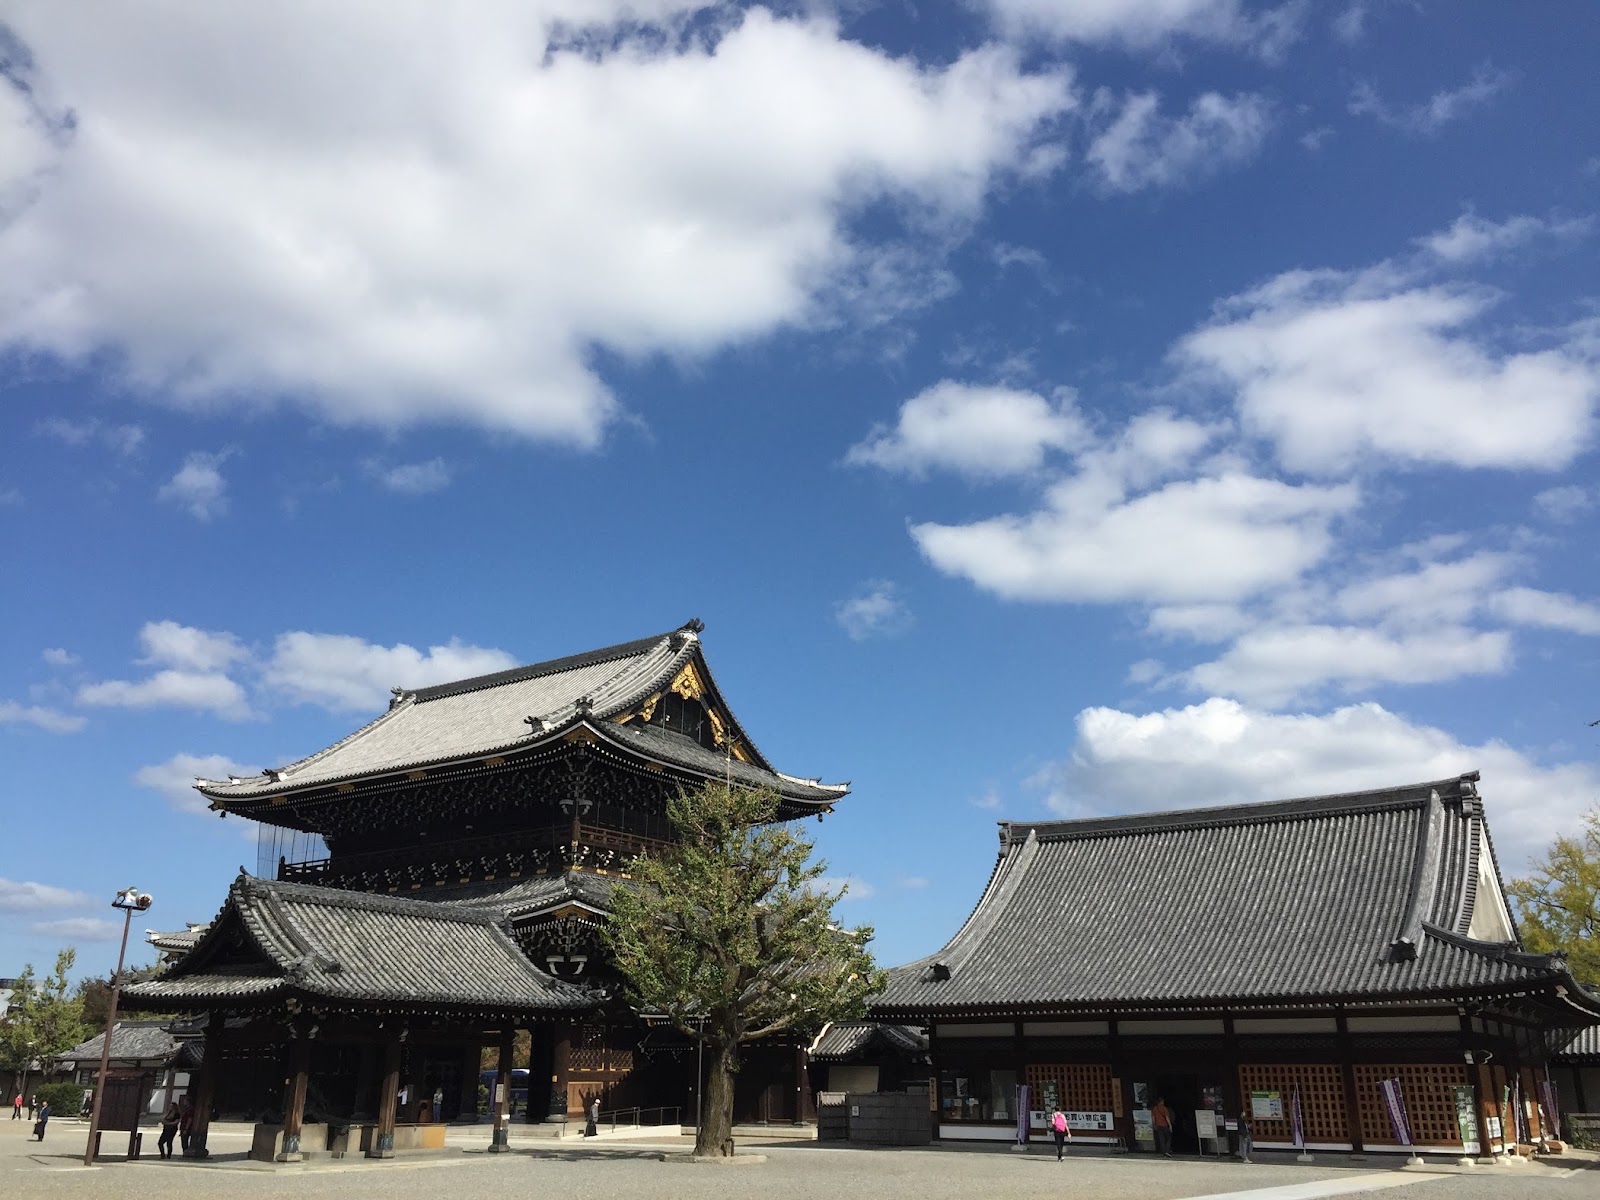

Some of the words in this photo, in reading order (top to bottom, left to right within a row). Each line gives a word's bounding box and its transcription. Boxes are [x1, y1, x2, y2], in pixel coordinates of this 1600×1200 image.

[1035, 1112, 1107, 1122] 東お買い物広場
